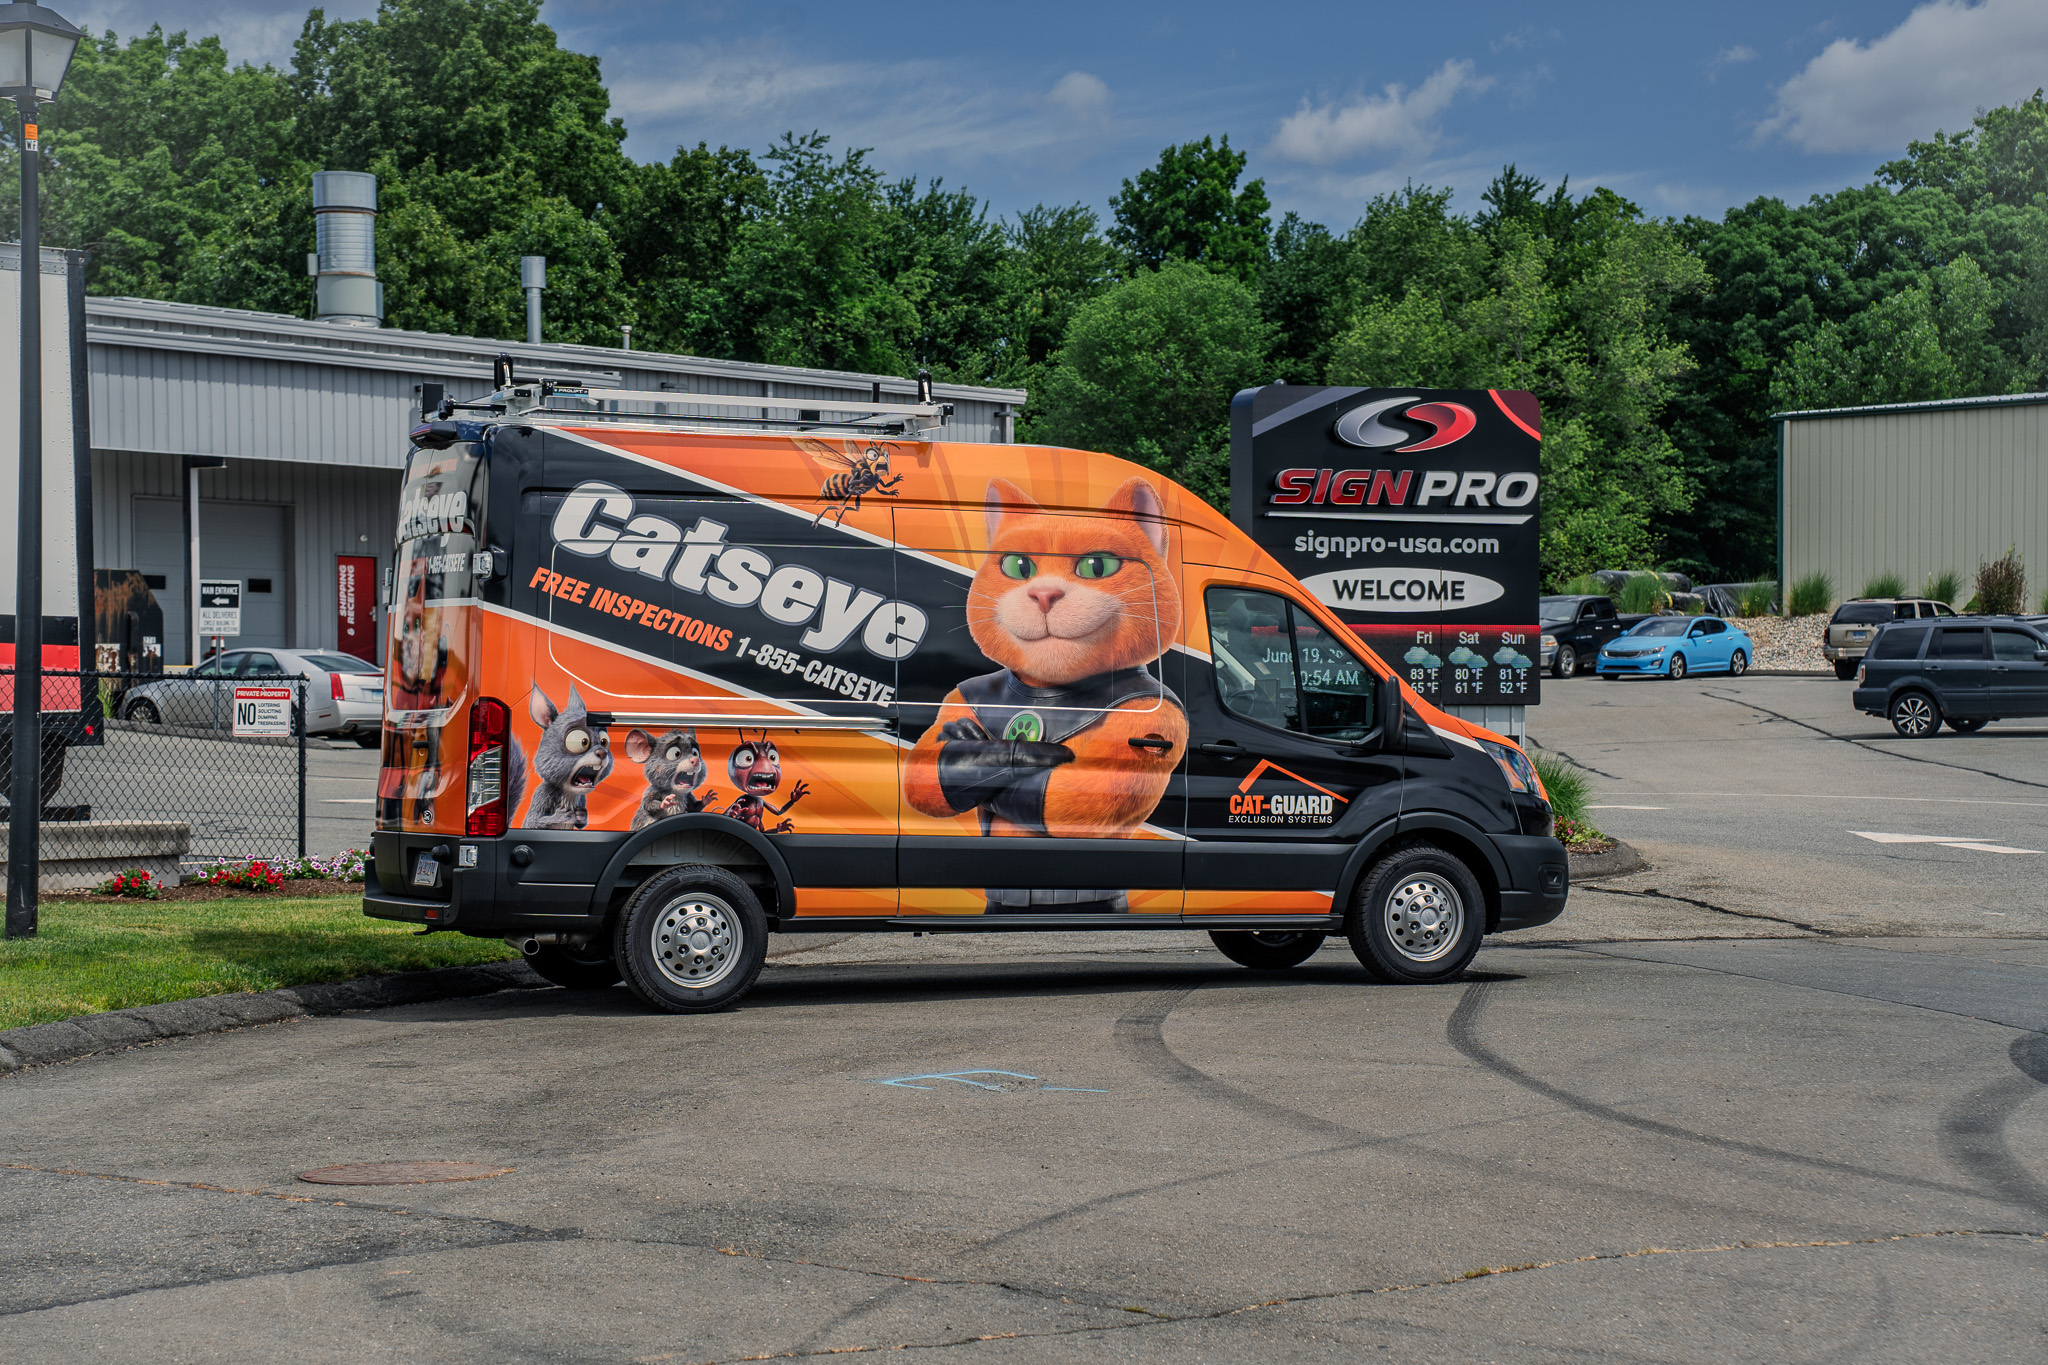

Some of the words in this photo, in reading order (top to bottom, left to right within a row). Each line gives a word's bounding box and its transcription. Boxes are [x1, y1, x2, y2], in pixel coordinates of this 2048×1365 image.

[1270, 468, 1413, 505] SIGN
[1415, 470, 1539, 507] PRO
[1294, 529, 1500, 558] signpro-usa.com
[550, 480, 929, 660] Catseye
[202, 586, 215, 595] MAIN
[215, 586, 238, 595] ENTRANCE
[339, 564, 347, 617] SHIPPING
[347, 565, 355, 624] RECEIVING
[1332, 579, 1466, 601] WELCOME
[529, 566, 591, 605] FREE
[588, 586, 734, 652] INSPECTIONS
[735, 636, 896, 708] 1-855-CATSEYE
[1416, 631, 1433, 644] Fri
[1459, 631, 1480, 644] Sat
[1501, 631, 1525, 644] Sun
[1335, 669, 1359, 685] AM
[1410, 668, 1424, 680] 83
[1455, 668, 1469, 680] 80
[1499, 668, 1512, 680] 81
[1455, 682, 1467, 694] 61
[1500, 682, 1514, 694] 52
[237, 702, 256, 725] NO
[1229, 794, 1333, 815] CAT-GUARD
[1228, 815, 1284, 824] EXCLUSION
[1287, 815, 1333, 824] SYSTEMS
